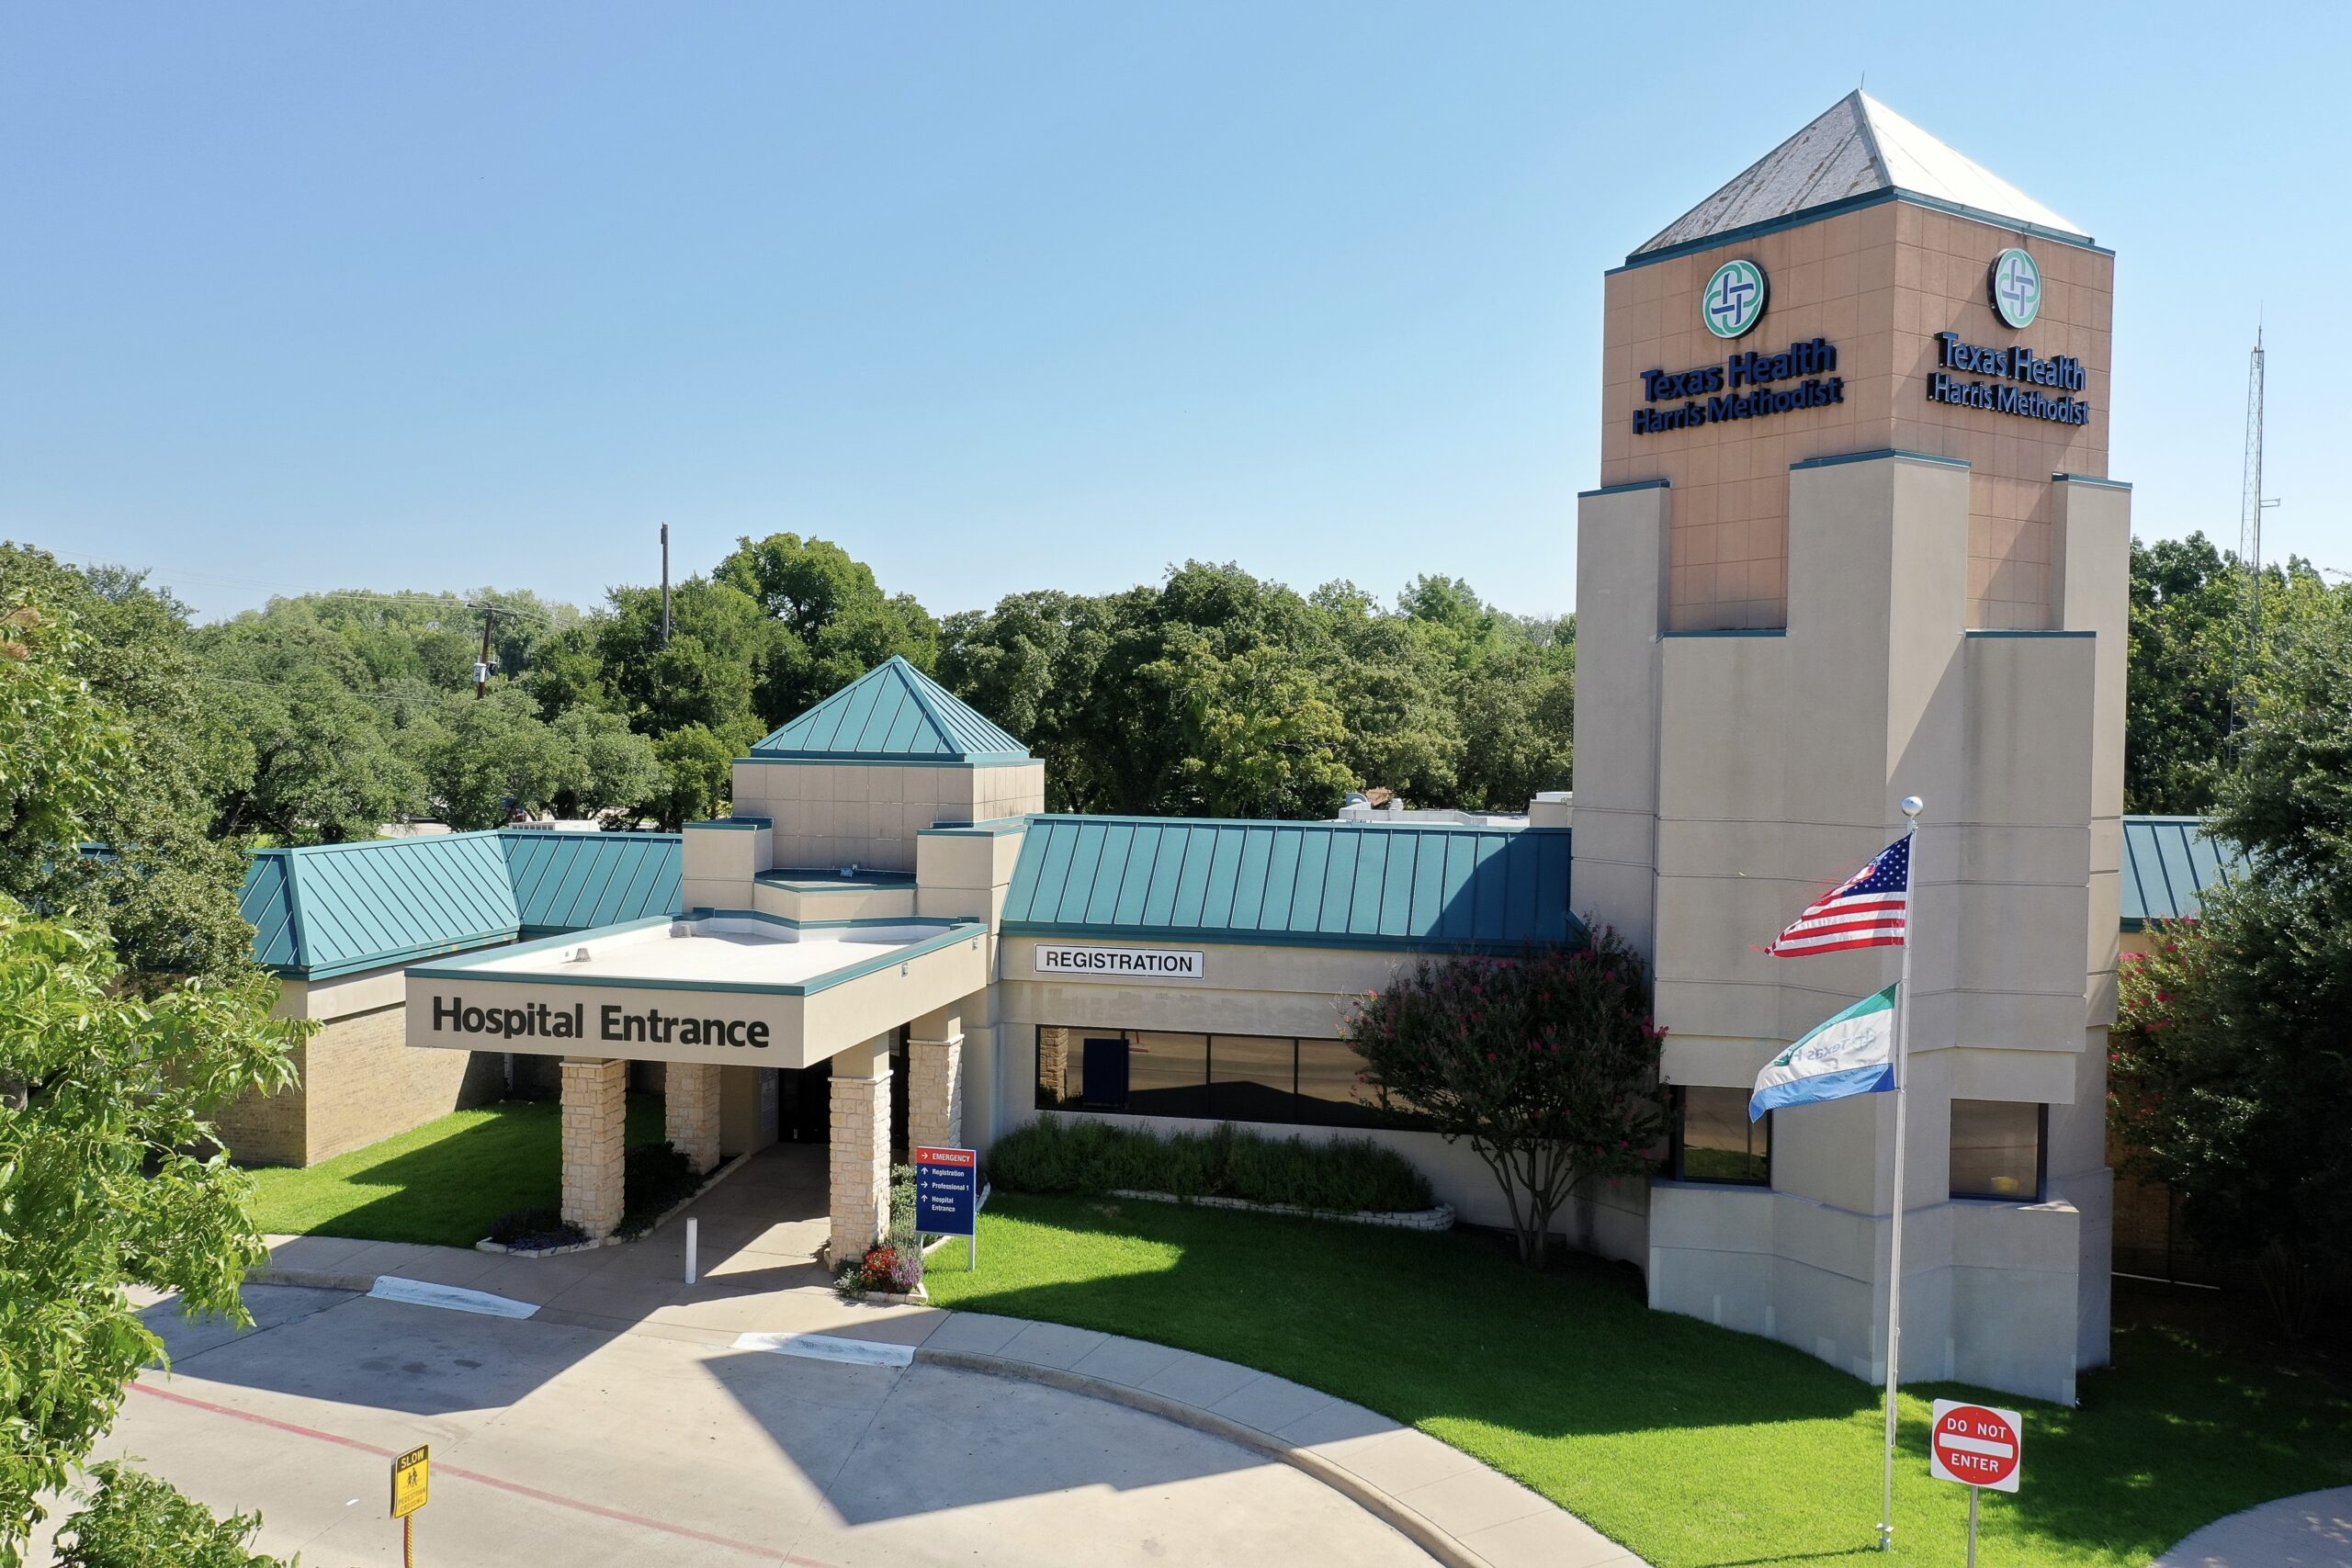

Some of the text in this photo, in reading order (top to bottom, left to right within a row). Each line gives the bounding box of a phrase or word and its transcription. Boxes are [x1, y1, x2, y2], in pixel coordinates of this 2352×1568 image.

[1640, 338, 1837, 402] Texas Health
[1936, 332, 2086, 391] Texas Health
[1633, 377, 1844, 434] Harris Methodist
[1929, 372, 2090, 425] Harris Methodist
[1046, 951, 1193, 972] REGISTRATION
[433, 996, 770, 1048] Hospital Entrance
[932, 1153, 970, 1162] EMERGENCY
[932, 1168, 965, 1177] Registration
[932, 1182, 965, 1190] Professional
[932, 1196, 954, 1204] Hospital
[932, 1204, 956, 1213] Entrance
[1947, 1417, 2007, 1438] DO NOT
[401, 1449, 424, 1469] SLOW
[1951, 1453, 1999, 1473] ENTER
